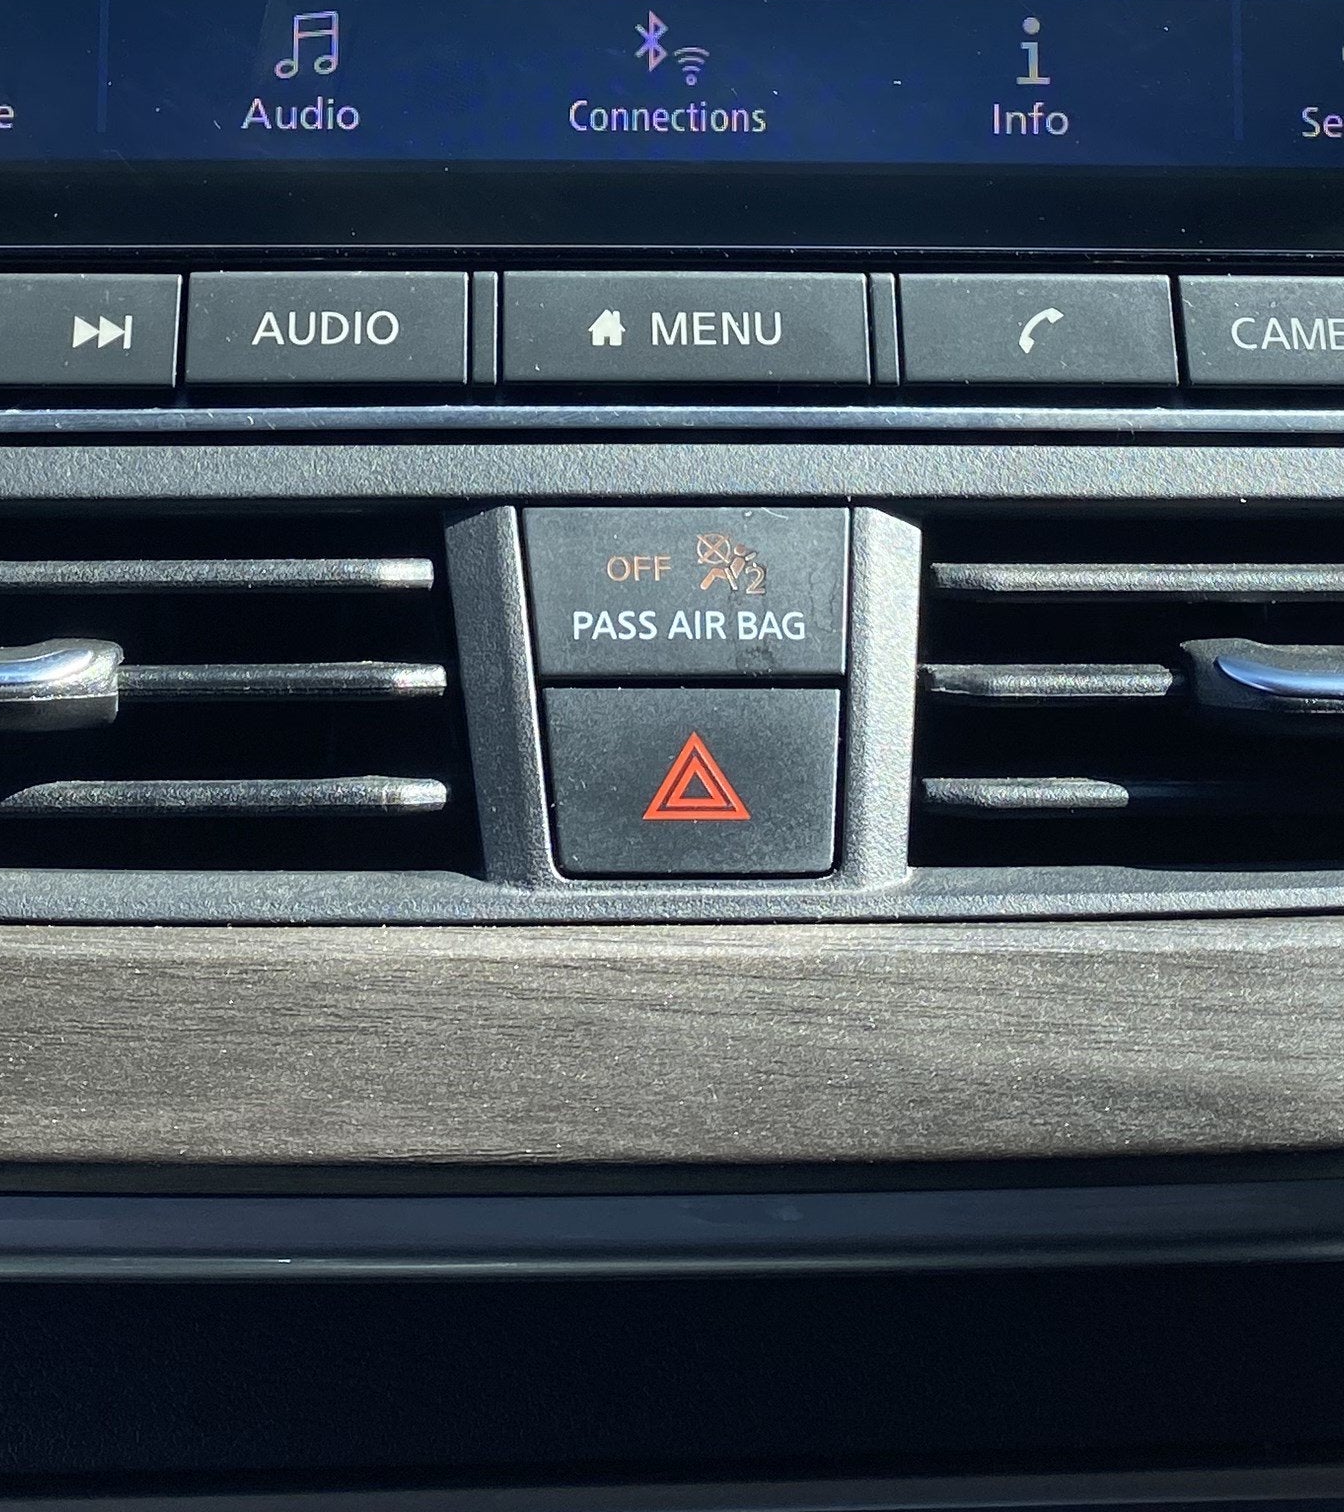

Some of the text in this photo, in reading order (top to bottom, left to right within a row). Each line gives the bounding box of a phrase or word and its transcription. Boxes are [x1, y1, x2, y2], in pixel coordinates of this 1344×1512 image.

[240, 96, 360, 131] Audio
[568, 99, 767, 134] Connections
[992, 101, 1069, 136] Info
[251, 310, 400, 346] AUDIO
[650, 311, 783, 346] MENU
[606, 555, 673, 582] OFF
[573, 610, 806, 641] PASS AIR BAG
